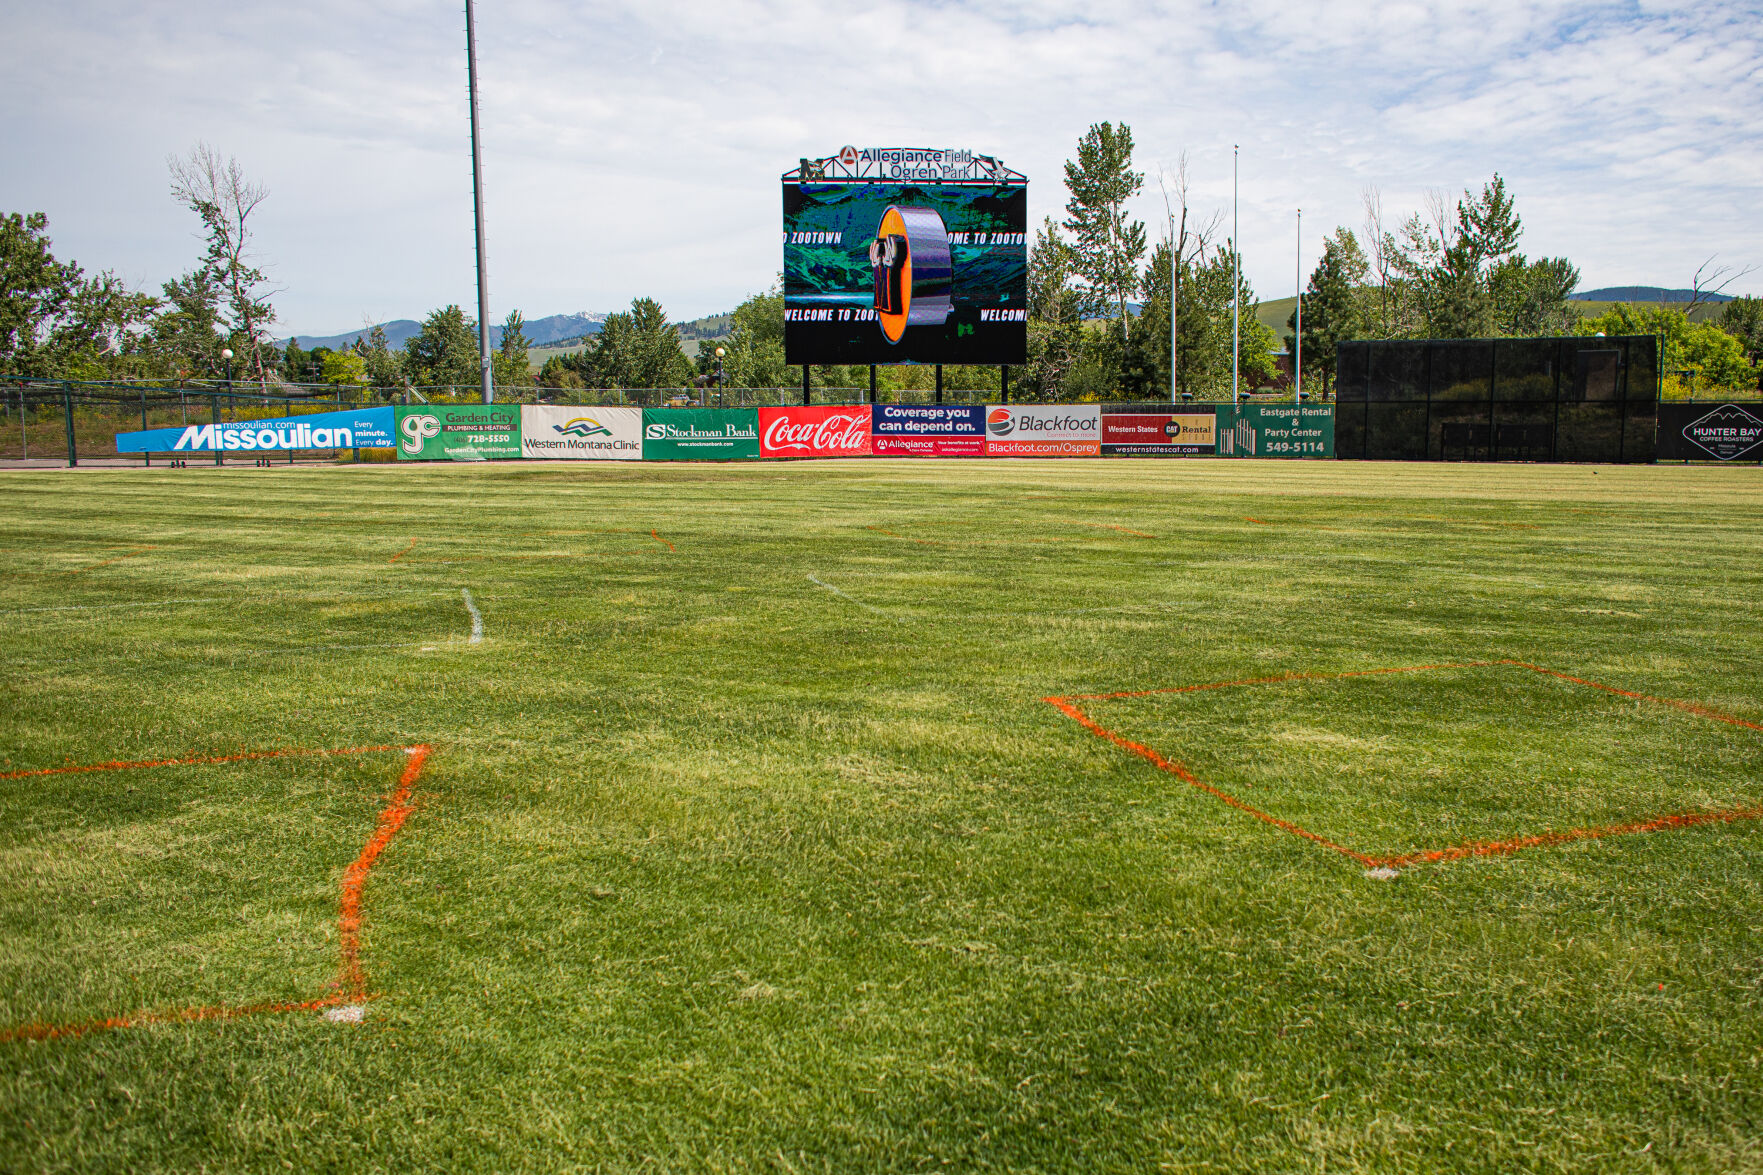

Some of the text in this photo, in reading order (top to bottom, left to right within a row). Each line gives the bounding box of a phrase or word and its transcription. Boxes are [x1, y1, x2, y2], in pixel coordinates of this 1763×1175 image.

[861, 148, 971, 164] Allegiance Field
[890, 165, 970, 182] Ogren Park
[791, 232, 842, 244] ZOOTOWN
[974, 232, 987, 244] TO
[784, 308, 879, 321] WELCOME TO ZOOT
[446, 412, 514, 424] Garden City
[884, 407, 970, 420] Coverage you
[1260, 407, 1332, 418] Eastgate Rental
[223, 420, 296, 429] missoulian.com
[354, 421, 373, 429] Every
[879, 420, 976, 433] can depend on.
[1019, 415, 1097, 431] Blackfoot
[1291, 418, 1299, 426] &
[666, 424, 757, 437] Stockman Bank
[764, 414, 871, 450] Coca-Cola
[1108, 425, 1158, 433] Western States
[1166, 425, 1178, 433] CAT
[1182, 425, 1211, 433] Rental
[1265, 428, 1322, 438] Party Center
[1693, 428, 1762, 436] HUNTER BAY
[173, 423, 353, 450] Missoulian
[355, 438, 394, 447] Every day.
[467, 434, 510, 443] 728-5550
[524, 438, 640, 450] Western Montana Clinic
[888, 440, 934, 449] Allegiance
[988, 442, 1098, 454] Blackfoot.com/Osprey
[1266, 442, 1324, 452] 549-5114
